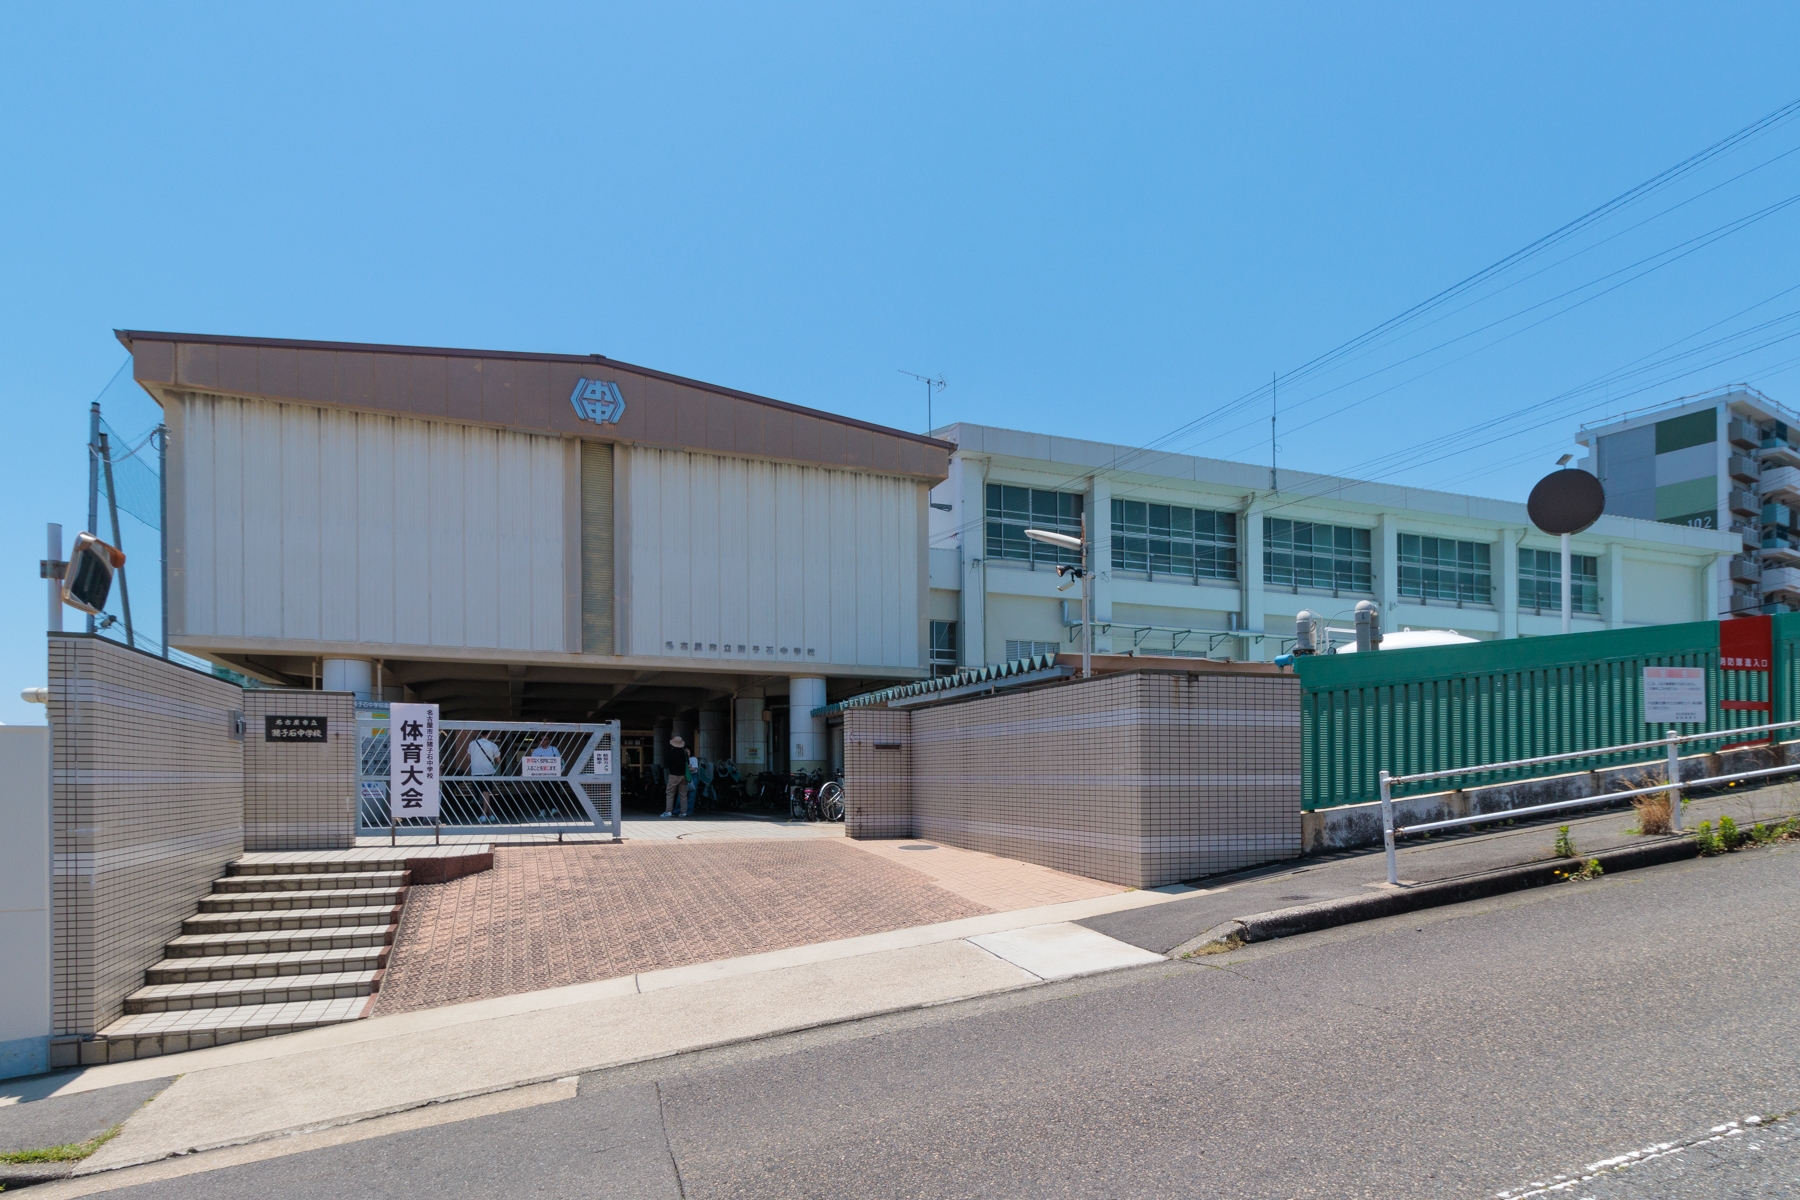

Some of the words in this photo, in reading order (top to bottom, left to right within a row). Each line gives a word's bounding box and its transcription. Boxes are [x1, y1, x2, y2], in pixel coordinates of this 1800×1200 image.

[1687, 516, 1712, 529] 102
[400, 720, 424, 809] 体育大会
